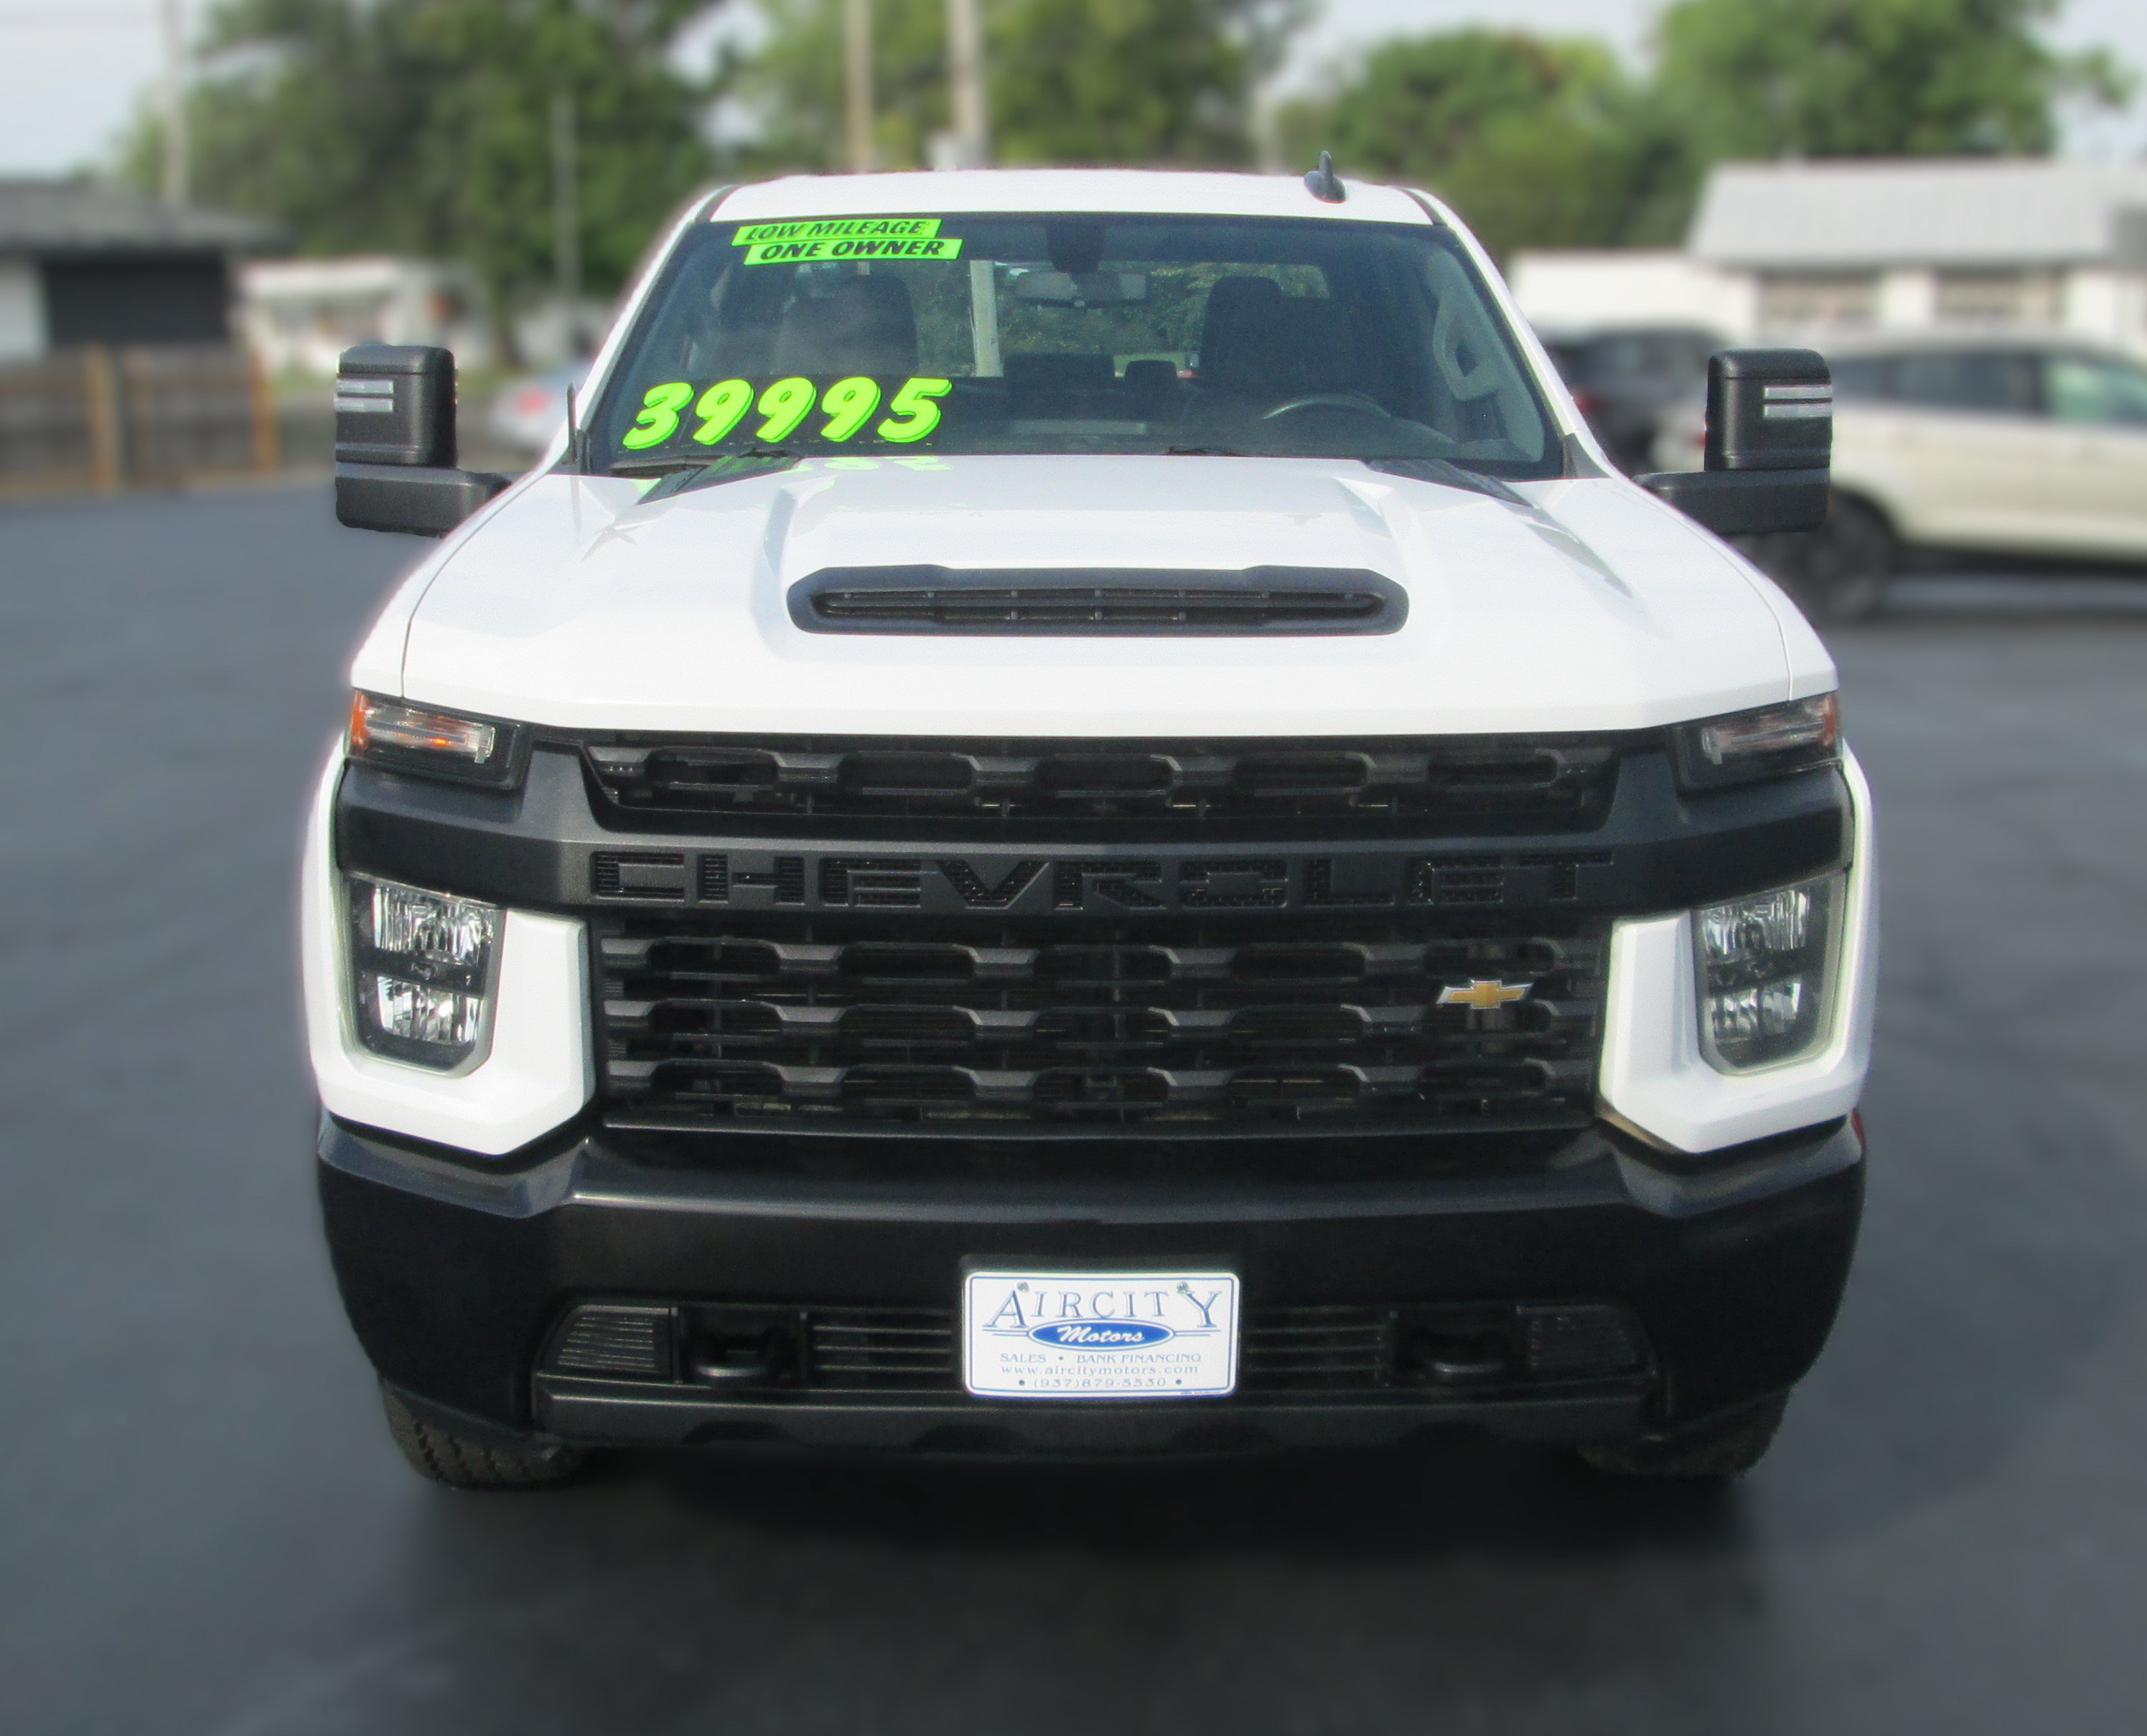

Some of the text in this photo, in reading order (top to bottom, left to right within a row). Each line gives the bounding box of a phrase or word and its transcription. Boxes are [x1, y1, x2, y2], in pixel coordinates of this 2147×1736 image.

[745, 220, 927, 241] LOW MILEAGE
[759, 240, 945, 260] ONE OWNER
[622, 375, 953, 450] 39995
[590, 851, 1615, 911] CHEVROLET
[982, 1290, 1222, 1328] AIRCITY
[1057, 1325, 1145, 1343] Motors
[1000, 1353, 1201, 1364] SALES BANK FINANCING
[1001, 1364, 1199, 1376] www.aircitymotors.com
